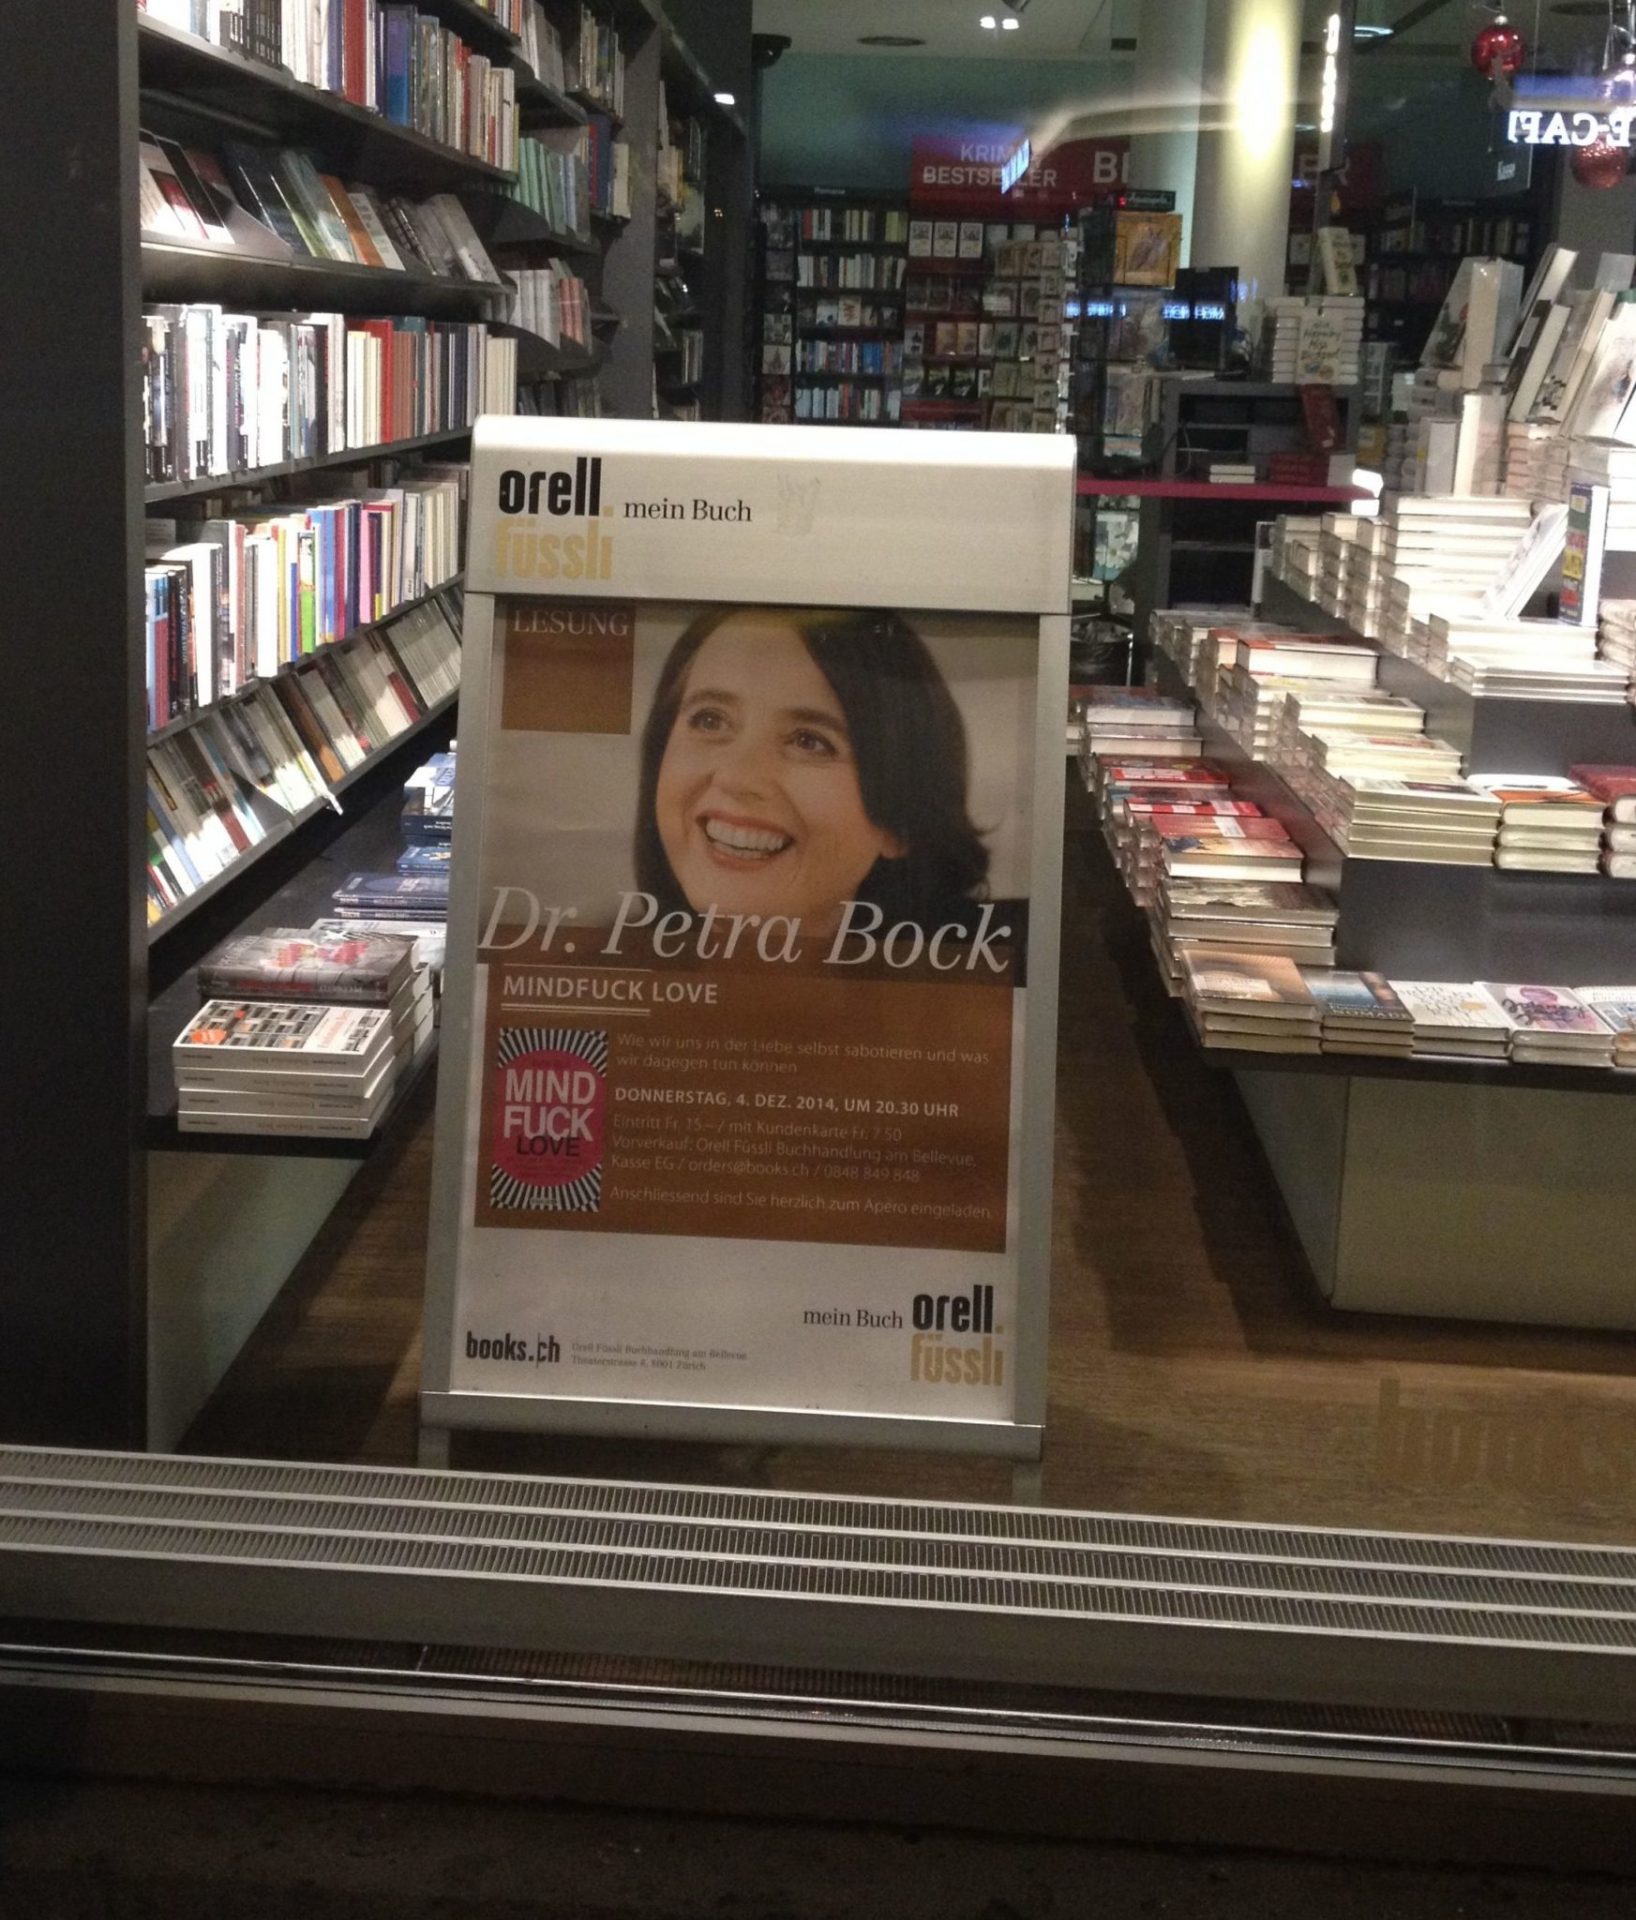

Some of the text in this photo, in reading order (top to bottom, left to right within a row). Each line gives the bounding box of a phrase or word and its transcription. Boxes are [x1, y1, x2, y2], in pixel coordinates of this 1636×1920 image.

[923, 166, 1057, 188] BESTSELER
[498, 456, 602, 517] orell
[622, 498, 752, 522] mein Buch
[495, 510, 614, 580] füssli
[514, 610, 629, 637] LESUNG
[477, 886, 1012, 973] Dr. Petra Bock
[503, 976, 718, 1004] MINDFUCK LOVE
[616, 1053, 639, 1066] wir
[643, 1054, 708, 1072] dagegen
[713, 1059, 737, 1071] tun
[617, 1033, 990, 1065] Wie wir uns in der Liebe selbst sabotieren und was
[505, 1068, 597, 1105] MIND
[615, 1087, 959, 1118] DONNERSTAG, 4. DEZ. 2014, UM 20.30 UHR
[503, 1105, 594, 1142] FUCK
[613, 1114, 660, 1129] Eintritt
[729, 1119, 752, 1134] mit
[757, 1121, 848, 1139] Kundenkarte
[516, 1135, 581, 1157] LOVE
[696, 1137, 730, 1153] Orell
[777, 1141, 881, 1162] Buchhandlung
[885, 1150, 909, 1162] am
[611, 1154, 651, 1169] Kasse
[655, 1155, 674, 1170] EG
[824, 1164, 859, 1180] 0848
[610, 1186, 709, 1204] Anschliessend
[714, 1190, 742, 1205] sind
[746, 1191, 766, 1206] Sie
[770, 1192, 825, 1209] herzlich
[829, 1198, 860, 1211] zum
[803, 1308, 904, 1329] mein Buch
[912, 1284, 993, 1334] orell
[465, 1331, 560, 1363] books.ch
[910, 1332, 1004, 1386] füssli
